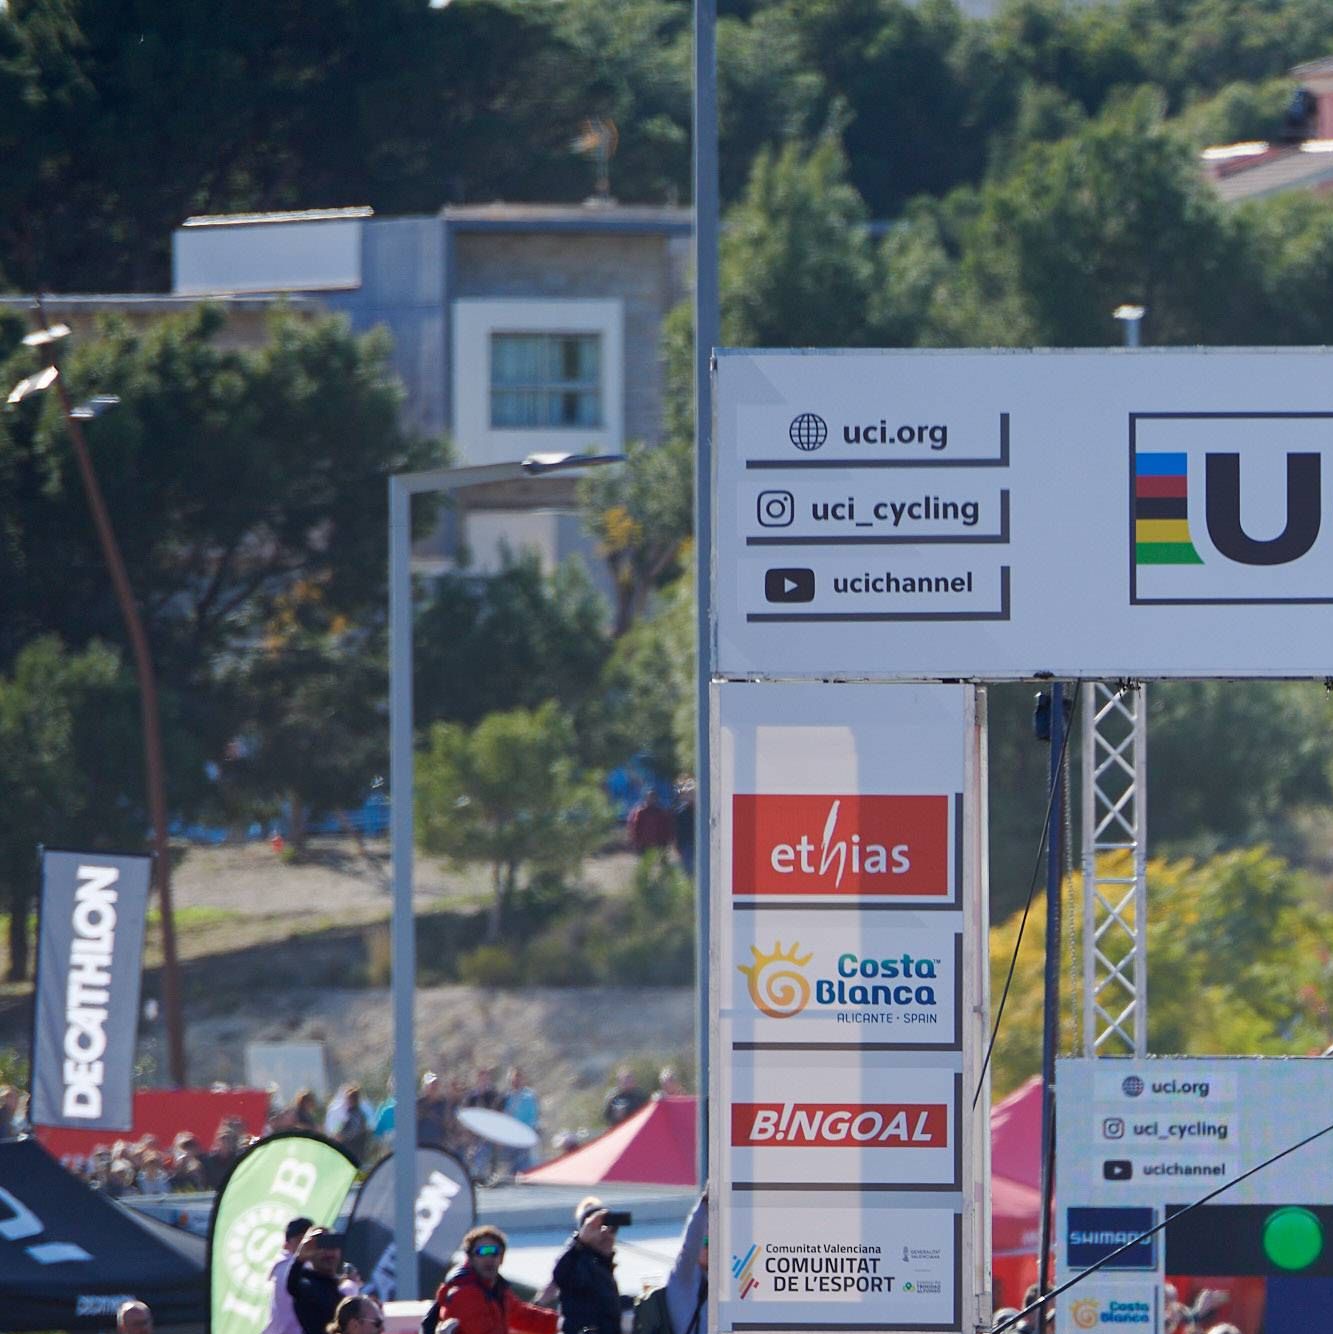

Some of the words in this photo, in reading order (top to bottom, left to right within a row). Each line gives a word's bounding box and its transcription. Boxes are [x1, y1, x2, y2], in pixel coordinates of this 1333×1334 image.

[842, 419, 949, 451] uci.org
[811, 495, 980, 527] uci_cycling
[832, 570, 974, 595] ucichannel
[770, 800, 911, 889] ethias
[837, 953, 937, 979] Costa
[62, 865, 119, 1119] DECATHLON
[815, 979, 937, 1006] Blanca
[837, 1013, 893, 1024] ALICANTE
[903, 1013, 937, 1024] SPAIN
[1151, 1079, 1210, 1098] uci.org
[1133, 1122, 1228, 1139] uci_cycling
[1143, 1163, 1226, 1177] ucichannel
[765, 1243, 821, 1254] Comunitat
[823, 1243, 882, 1254] Valenciana
[765, 1257, 881, 1274] COMUNITAT
[773, 1276, 799, 1293] DE
[804, 1275, 896, 1293] L'ESPORT
